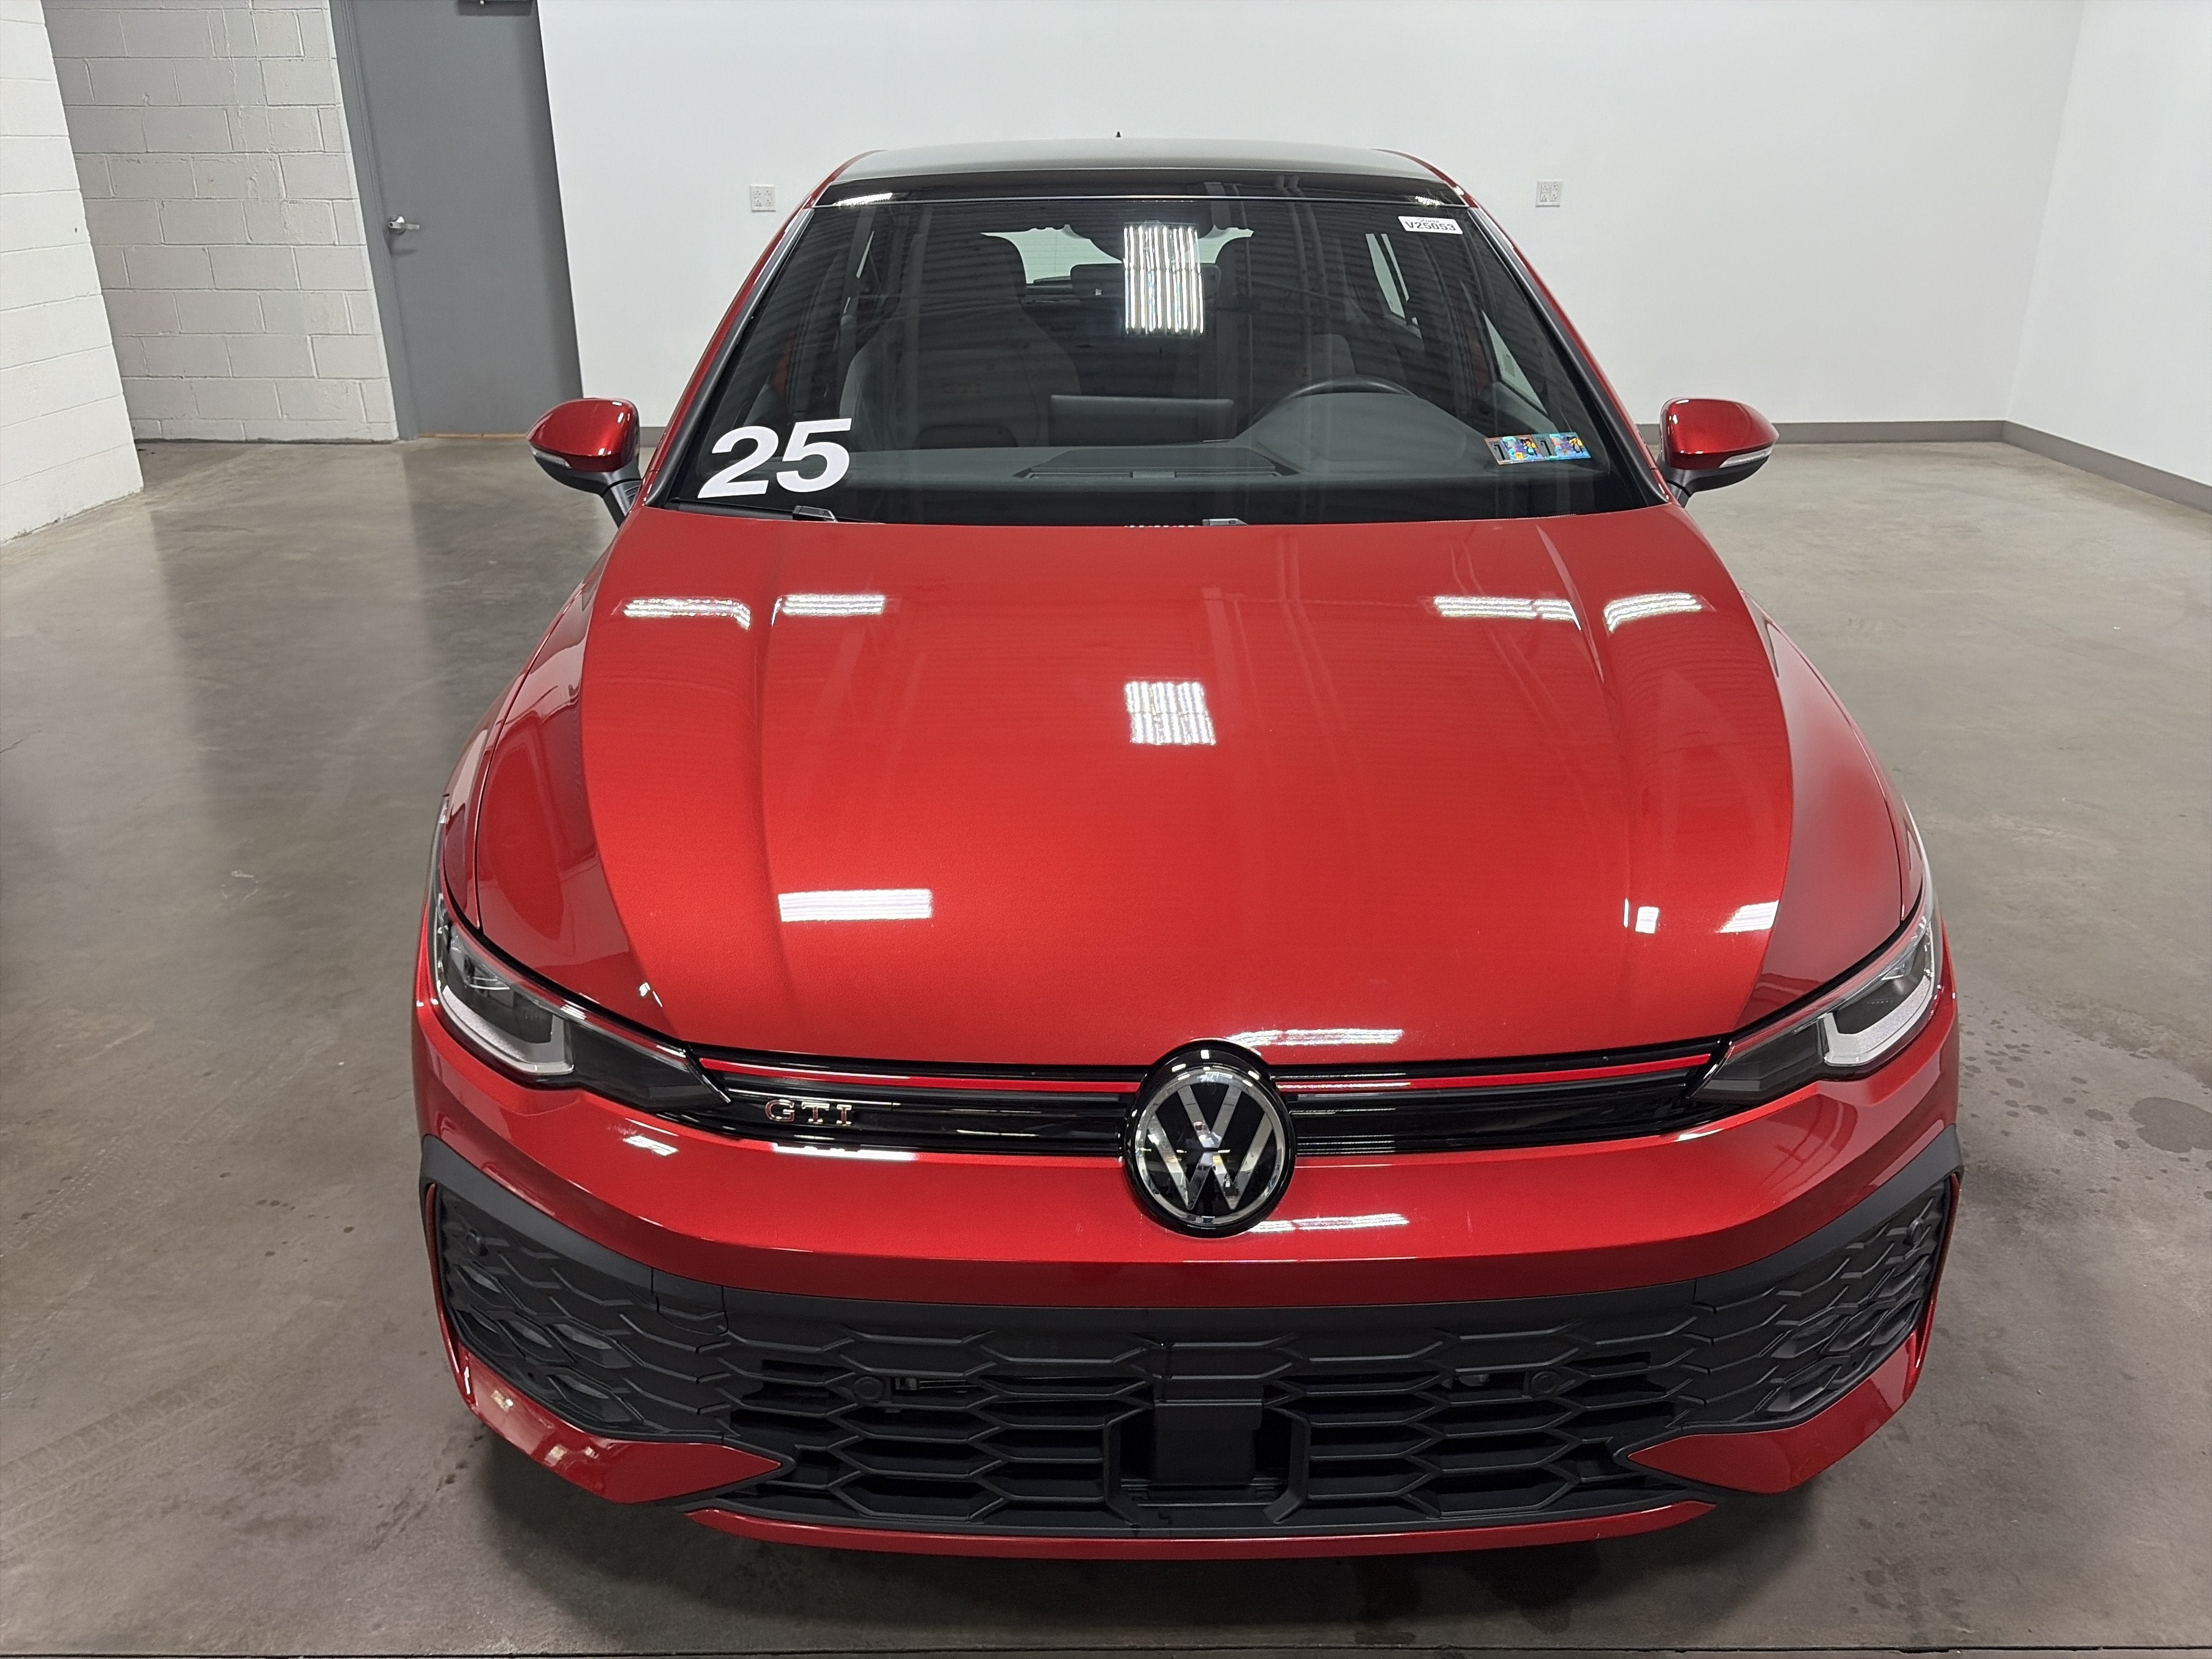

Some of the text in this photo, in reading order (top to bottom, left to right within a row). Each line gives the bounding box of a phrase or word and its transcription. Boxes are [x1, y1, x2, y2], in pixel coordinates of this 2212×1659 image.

[1405, 221, 1456, 231] V25053
[697, 418, 852, 499] 25
[765, 1099, 853, 1126] GTI
[1146, 1082, 1274, 1211] VW
